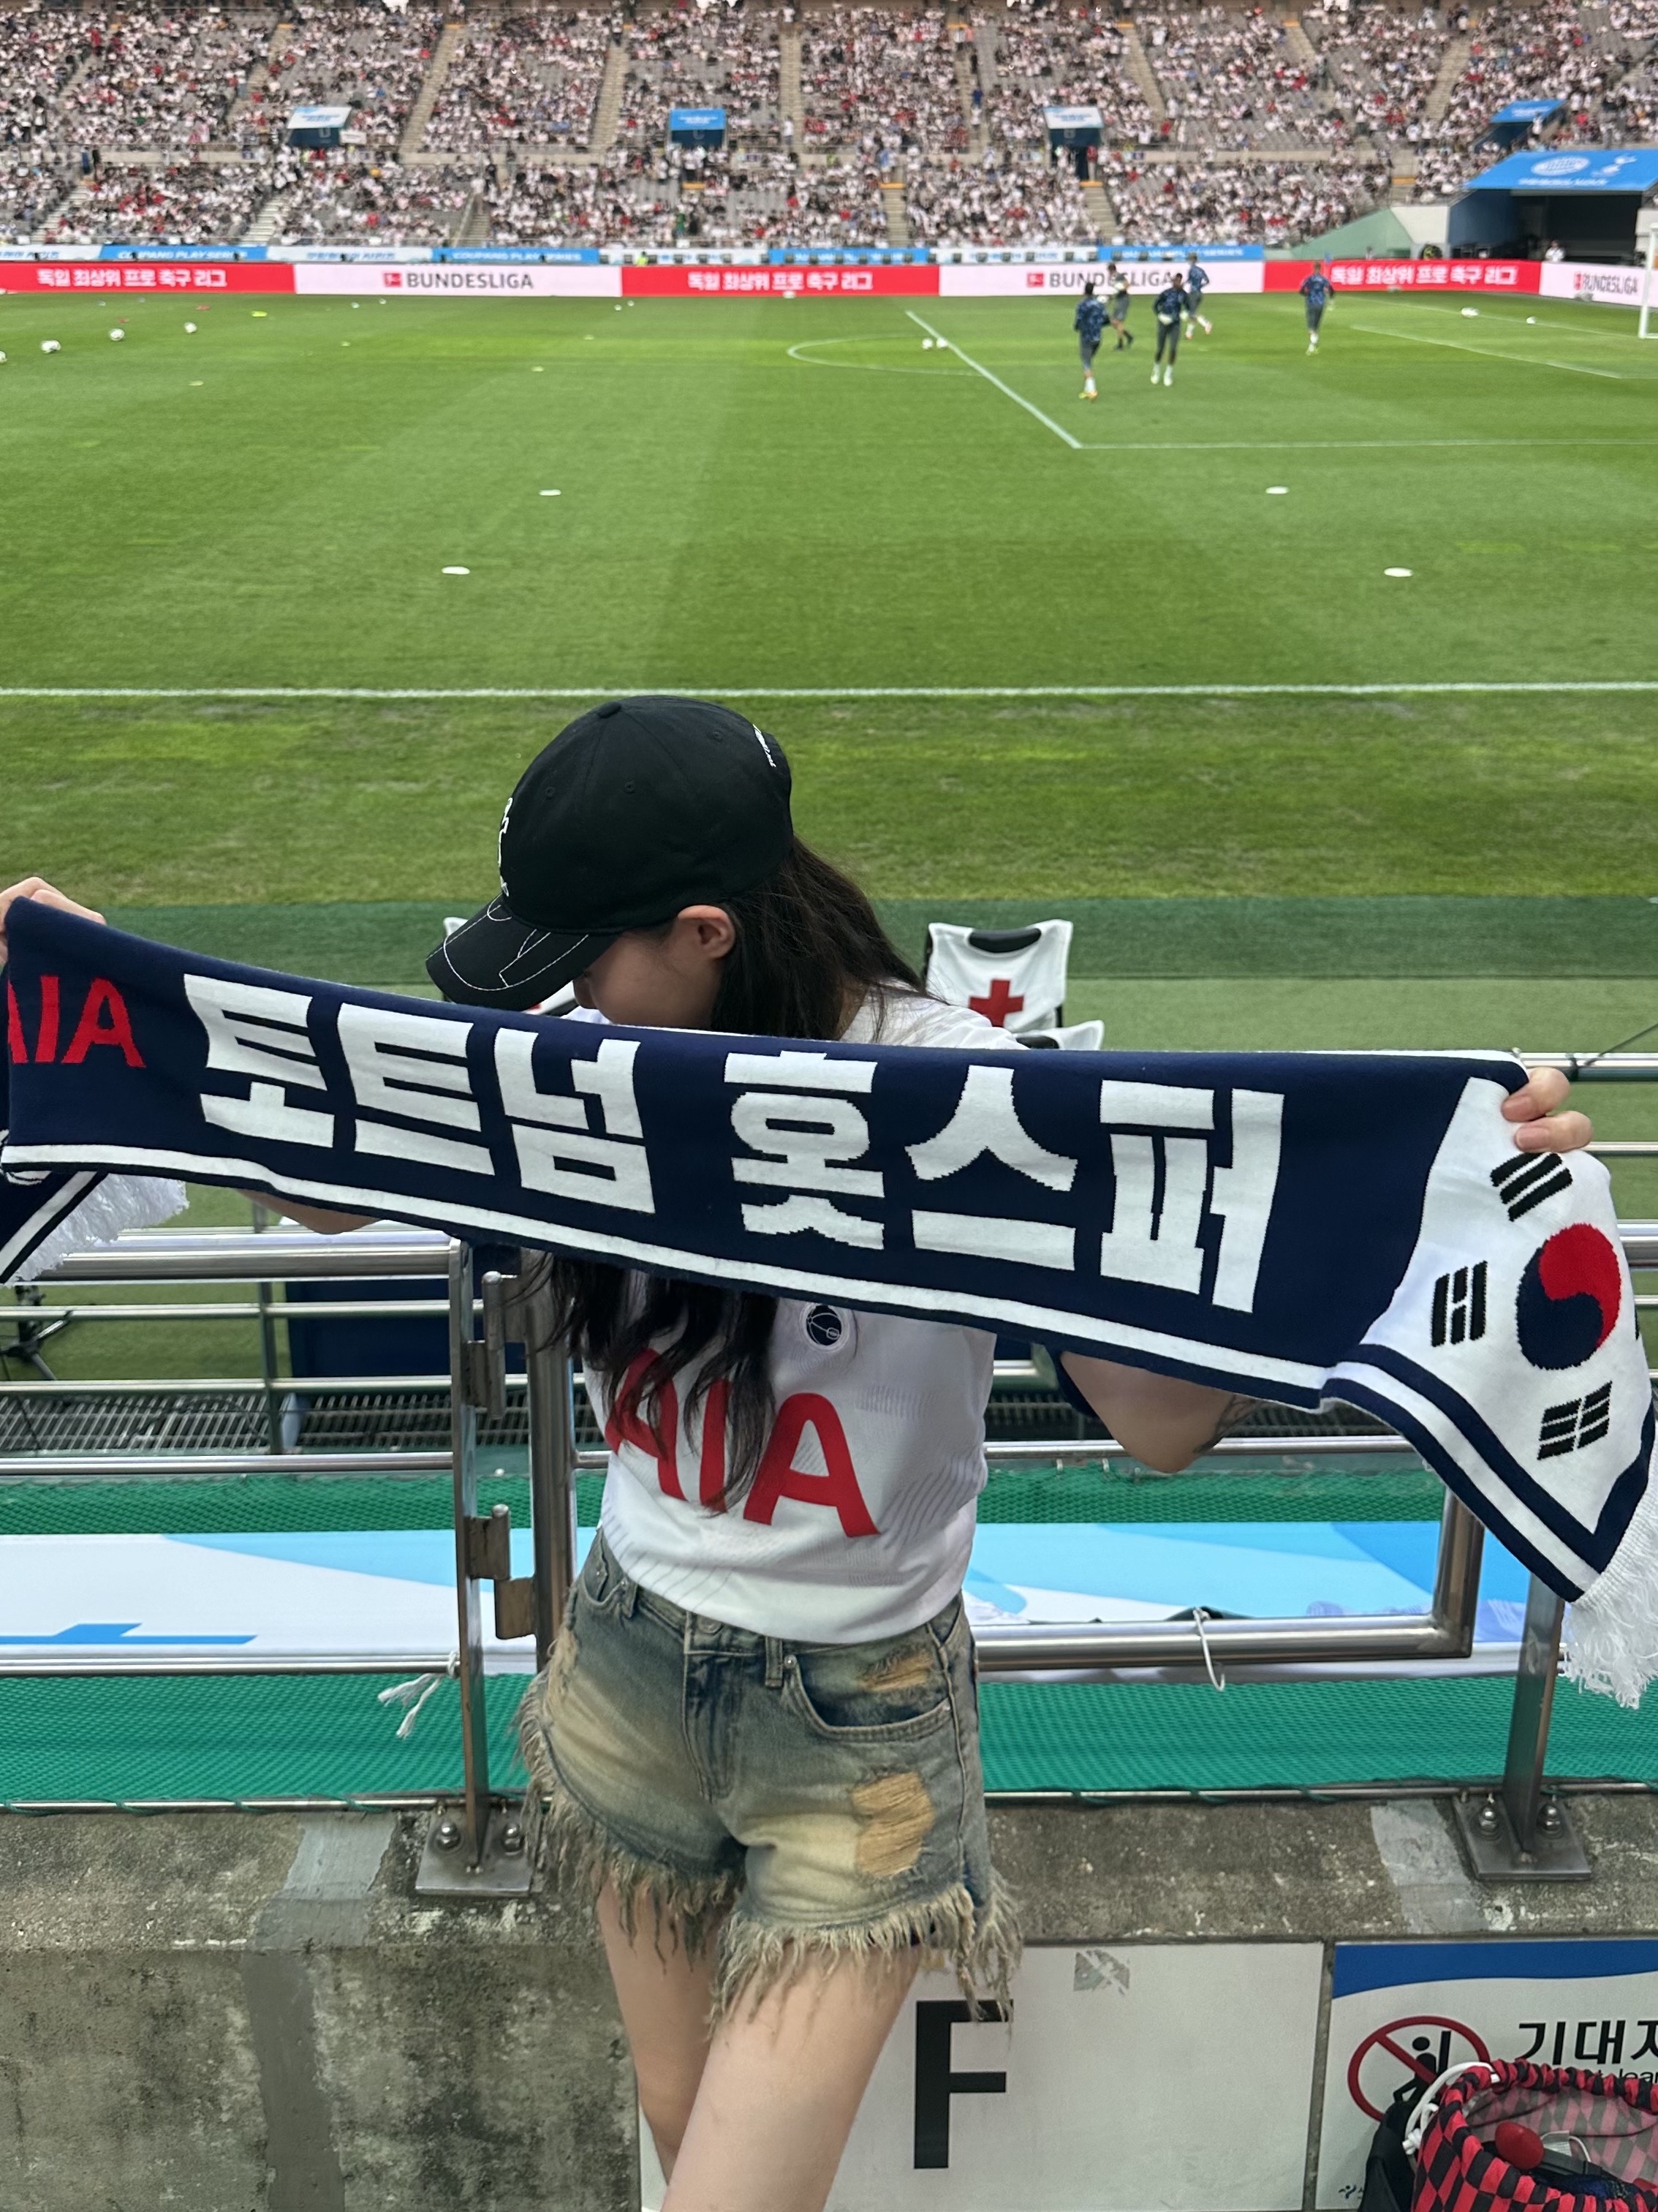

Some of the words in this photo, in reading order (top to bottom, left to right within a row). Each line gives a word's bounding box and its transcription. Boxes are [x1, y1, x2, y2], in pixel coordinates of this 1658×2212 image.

[38, 268, 71, 287] 독일
[74, 268, 121, 287] 최상위
[124, 268, 156, 287] 프로
[159, 268, 192, 287] 축구
[194, 268, 227, 287] 리그
[407, 273, 534, 289] BUNDESLIGA
[688, 271, 720, 290] 독일
[723, 271, 770, 290] 최상위
[772, 272, 804, 290] 프로
[806, 272, 839, 290] 축구
[841, 272, 873, 290] 리그
[1330, 266, 1363, 284] 독일
[1366, 266, 1415, 284] 최상위
[1416, 266, 1449, 284] 프로
[1450, 266, 1483, 284] 축구
[1485, 266, 1517, 284] 리그
[183, 974, 656, 1215] 토트넘
[724, 1051, 1284, 1313] 홋스퍼
[605, 1348, 882, 1538] AIA
[914, 1999, 1014, 2169] F
